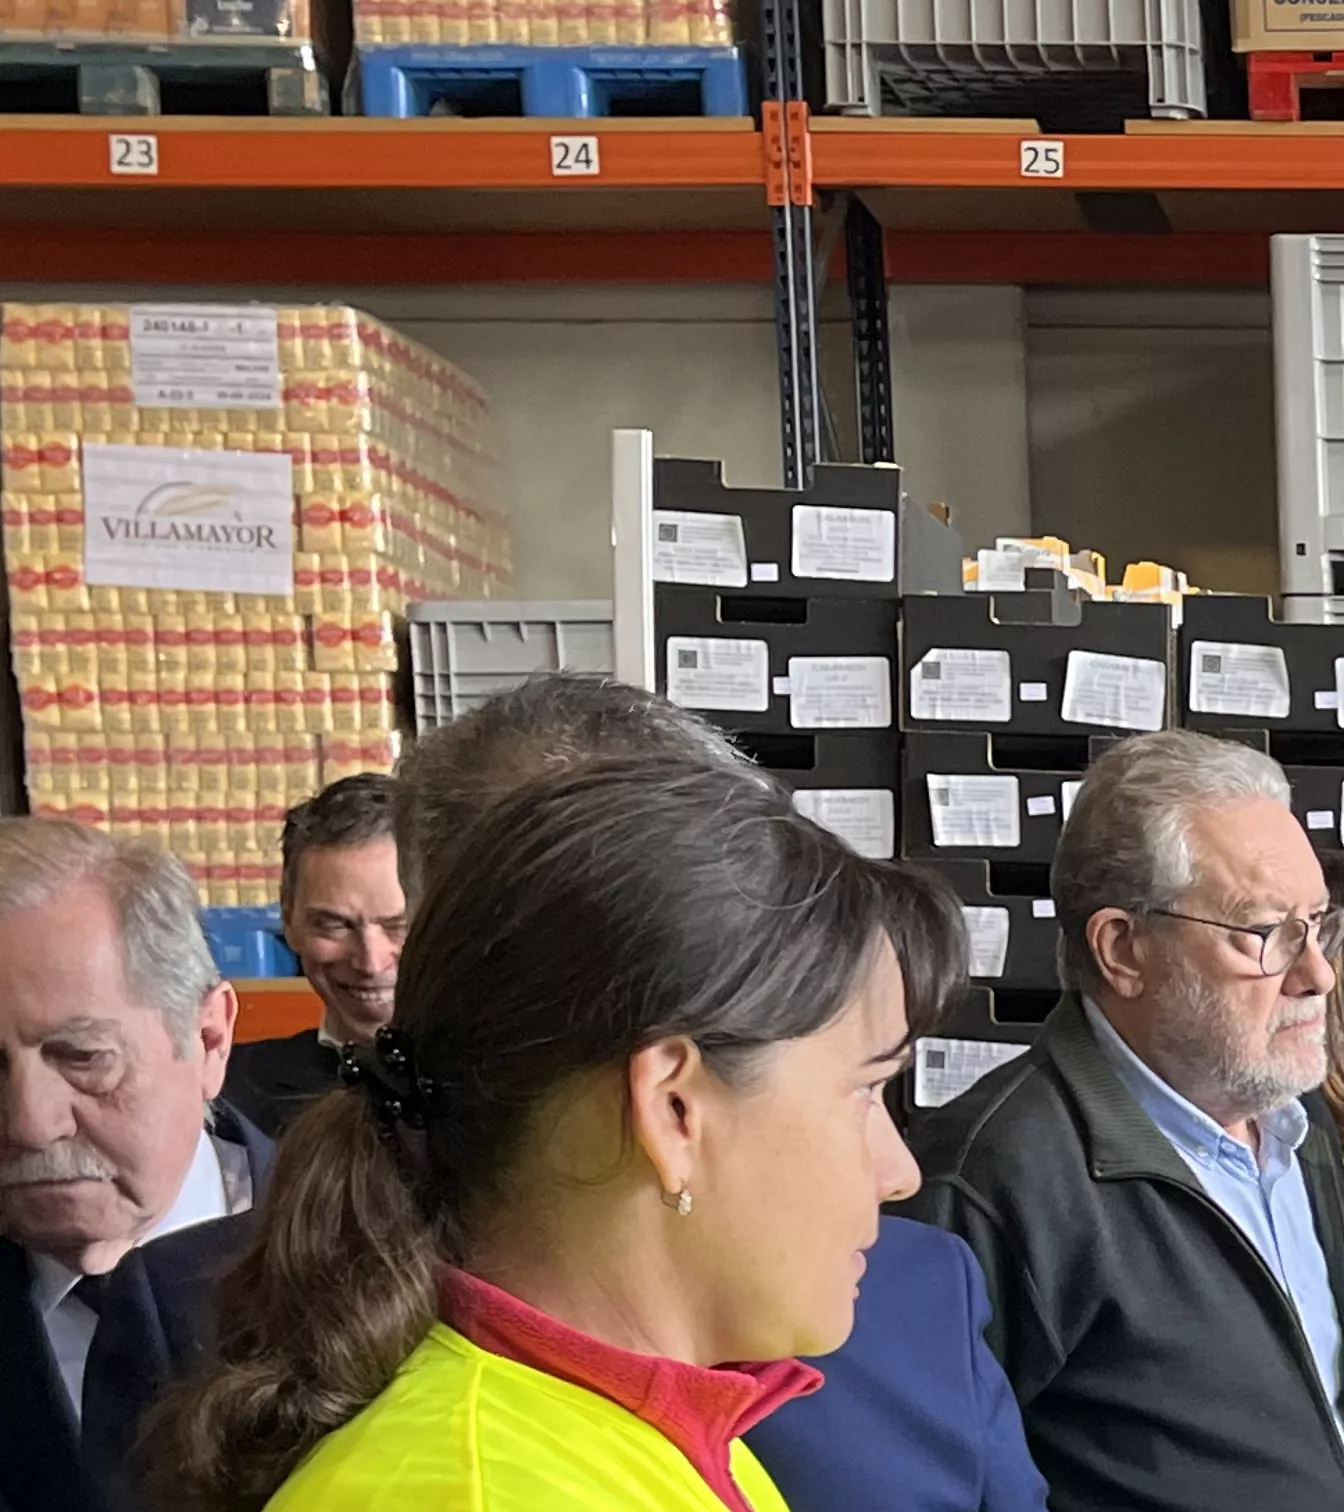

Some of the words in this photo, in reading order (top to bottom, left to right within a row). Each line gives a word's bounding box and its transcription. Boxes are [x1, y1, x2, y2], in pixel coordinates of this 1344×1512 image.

[116, 139, 155, 167] 23
[556, 142, 593, 169] 24
[1024, 146, 1060, 174] 25
[100, 516, 277, 548] VILLAMAYOR
